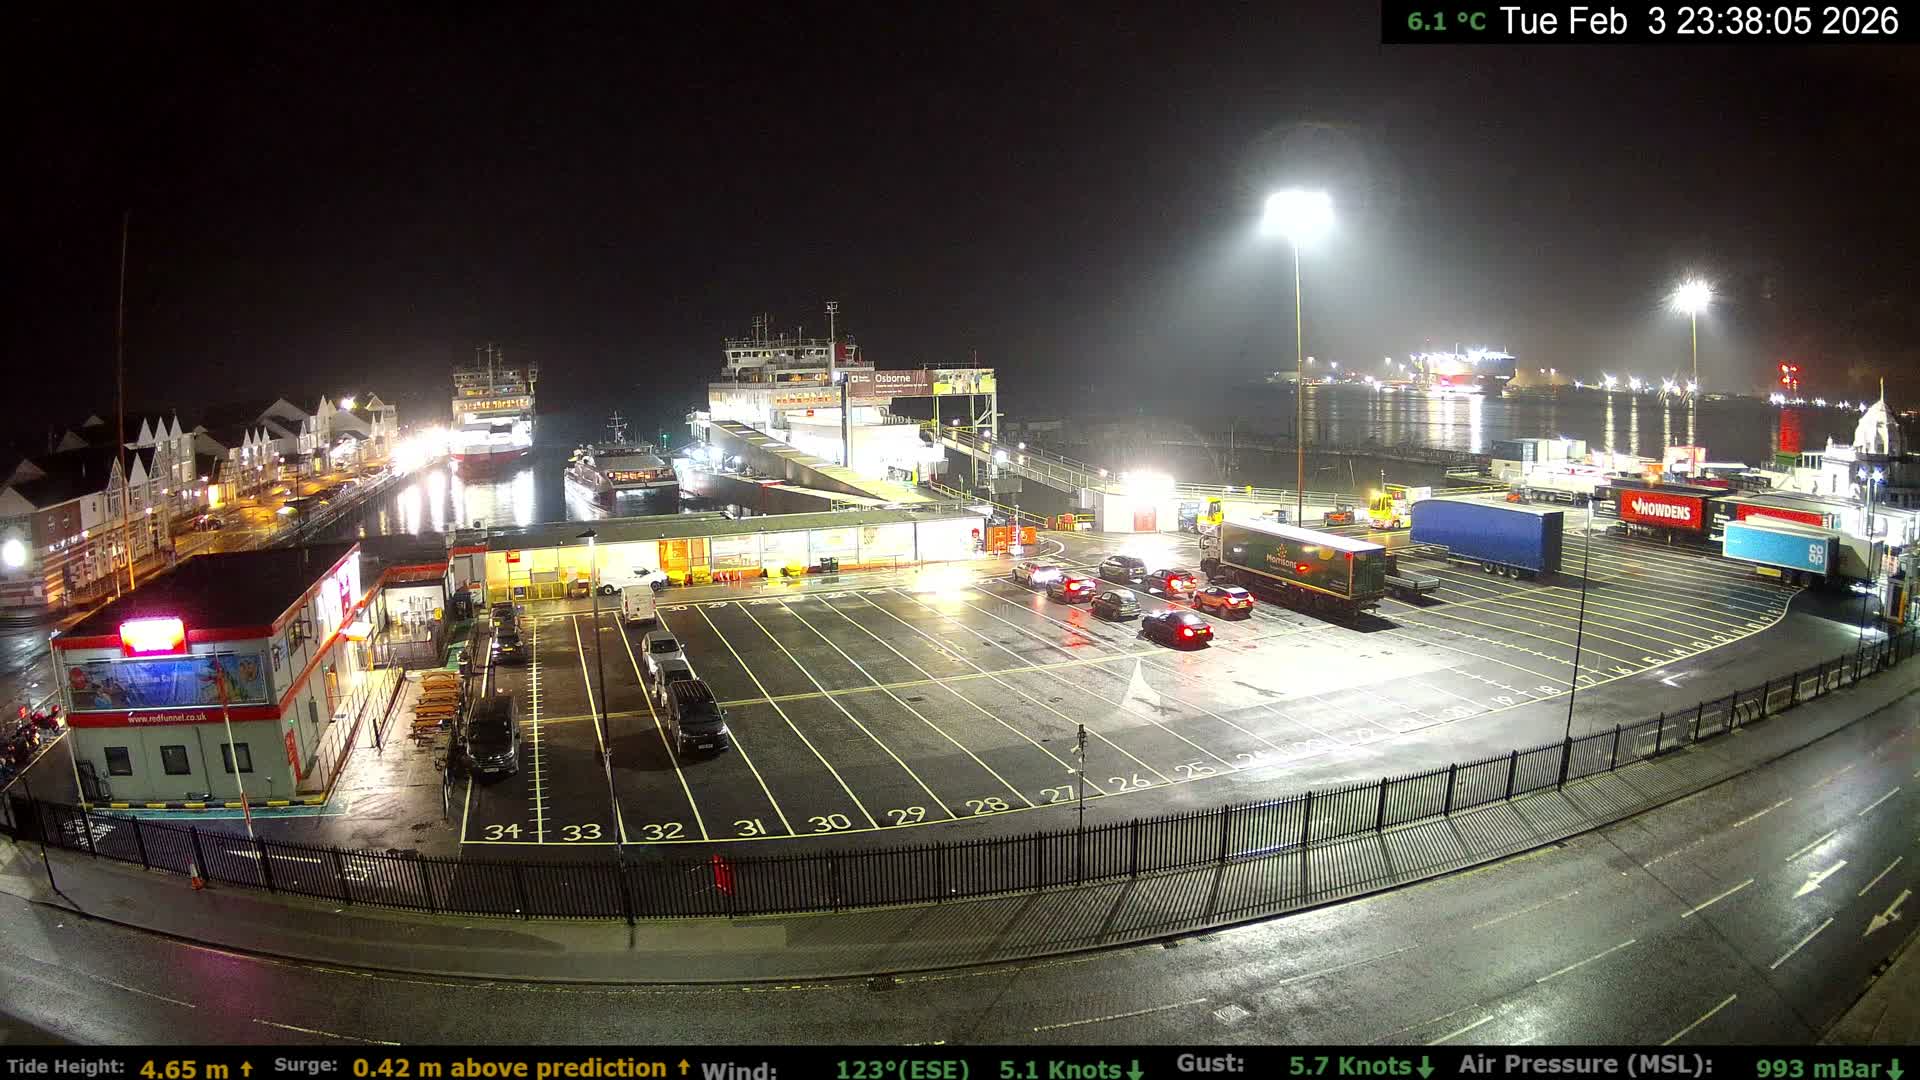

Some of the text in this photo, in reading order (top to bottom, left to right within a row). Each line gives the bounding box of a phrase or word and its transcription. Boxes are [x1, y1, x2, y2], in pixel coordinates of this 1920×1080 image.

[875, 374, 911, 382] Osborne
[1641, 502, 1691, 520] HOWDENS
[1266, 553, 1298, 569] Morrisons
[128, 712, 207, 723] www.redfunnel.co.uk
[1175, 762, 1218, 778] 25
[1108, 776, 1152, 792] 26
[1040, 785, 1076, 804] 27
[965, 797, 1010, 816] 28
[808, 813, 852, 833] 30
[887, 806, 926, 826] 29
[485, 823, 523, 840] 34
[562, 823, 602, 841] 33
[642, 822, 685, 841] 32
[733, 818, 766, 837] 31
